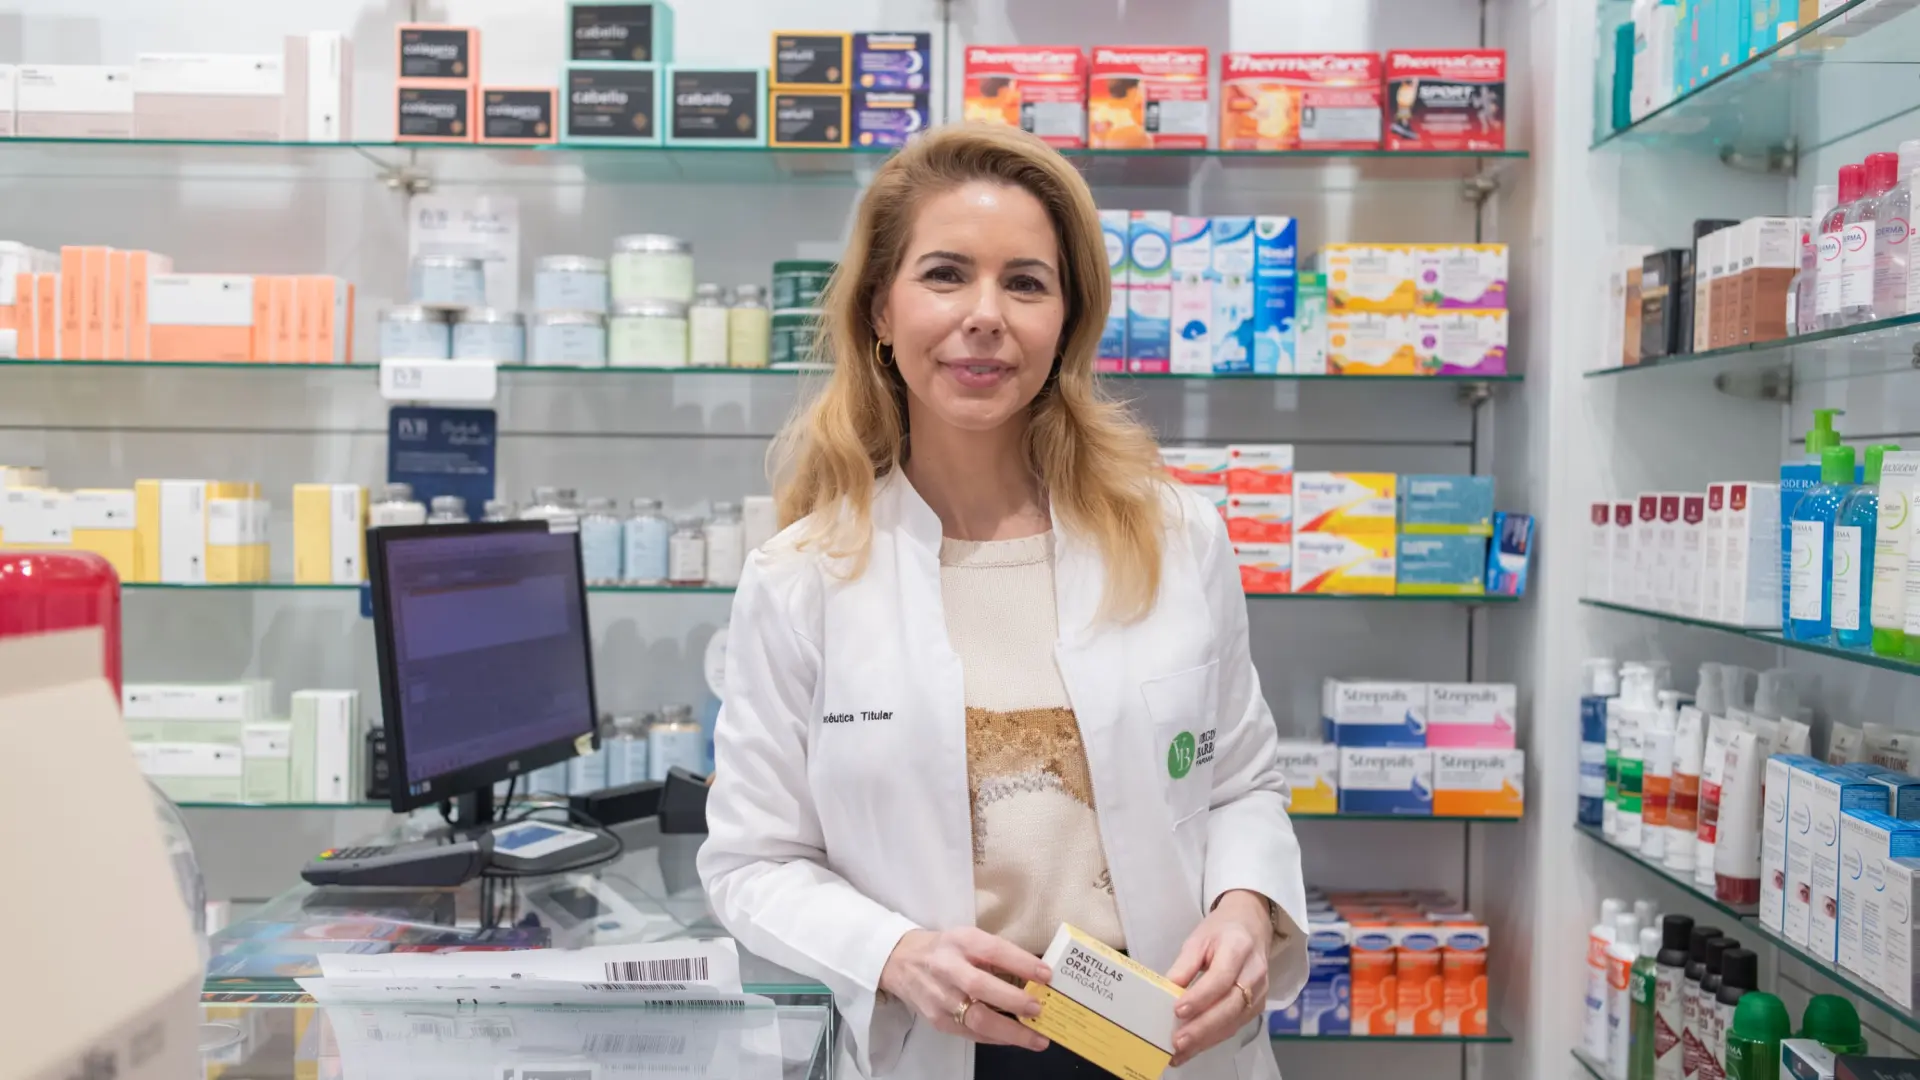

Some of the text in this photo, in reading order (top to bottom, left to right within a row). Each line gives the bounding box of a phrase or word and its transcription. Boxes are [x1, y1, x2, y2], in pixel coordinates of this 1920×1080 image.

[1229, 54, 1369, 72] ThermaCare
[1393, 53, 1501, 69] ThermaCare
[572, 89, 629, 105] cabello
[676, 92, 734, 107] cabello
[1419, 85, 1475, 100] SPORT
[1876, 226, 1904, 236] DERMA
[1343, 688, 1408, 703] Strepsils
[1433, 688, 1498, 703] Strepsils
[860, 710, 893, 721] Titular
[1276, 755, 1319, 768] epsils
[1349, 755, 1414, 769] Strepsils
[1441, 756, 1505, 770] Strepsils
[1065, 957, 1112, 987] ORALFLU
[1069, 947, 1124, 982] PASTILLAS
[1060, 966, 1115, 1001] GARGANTA
